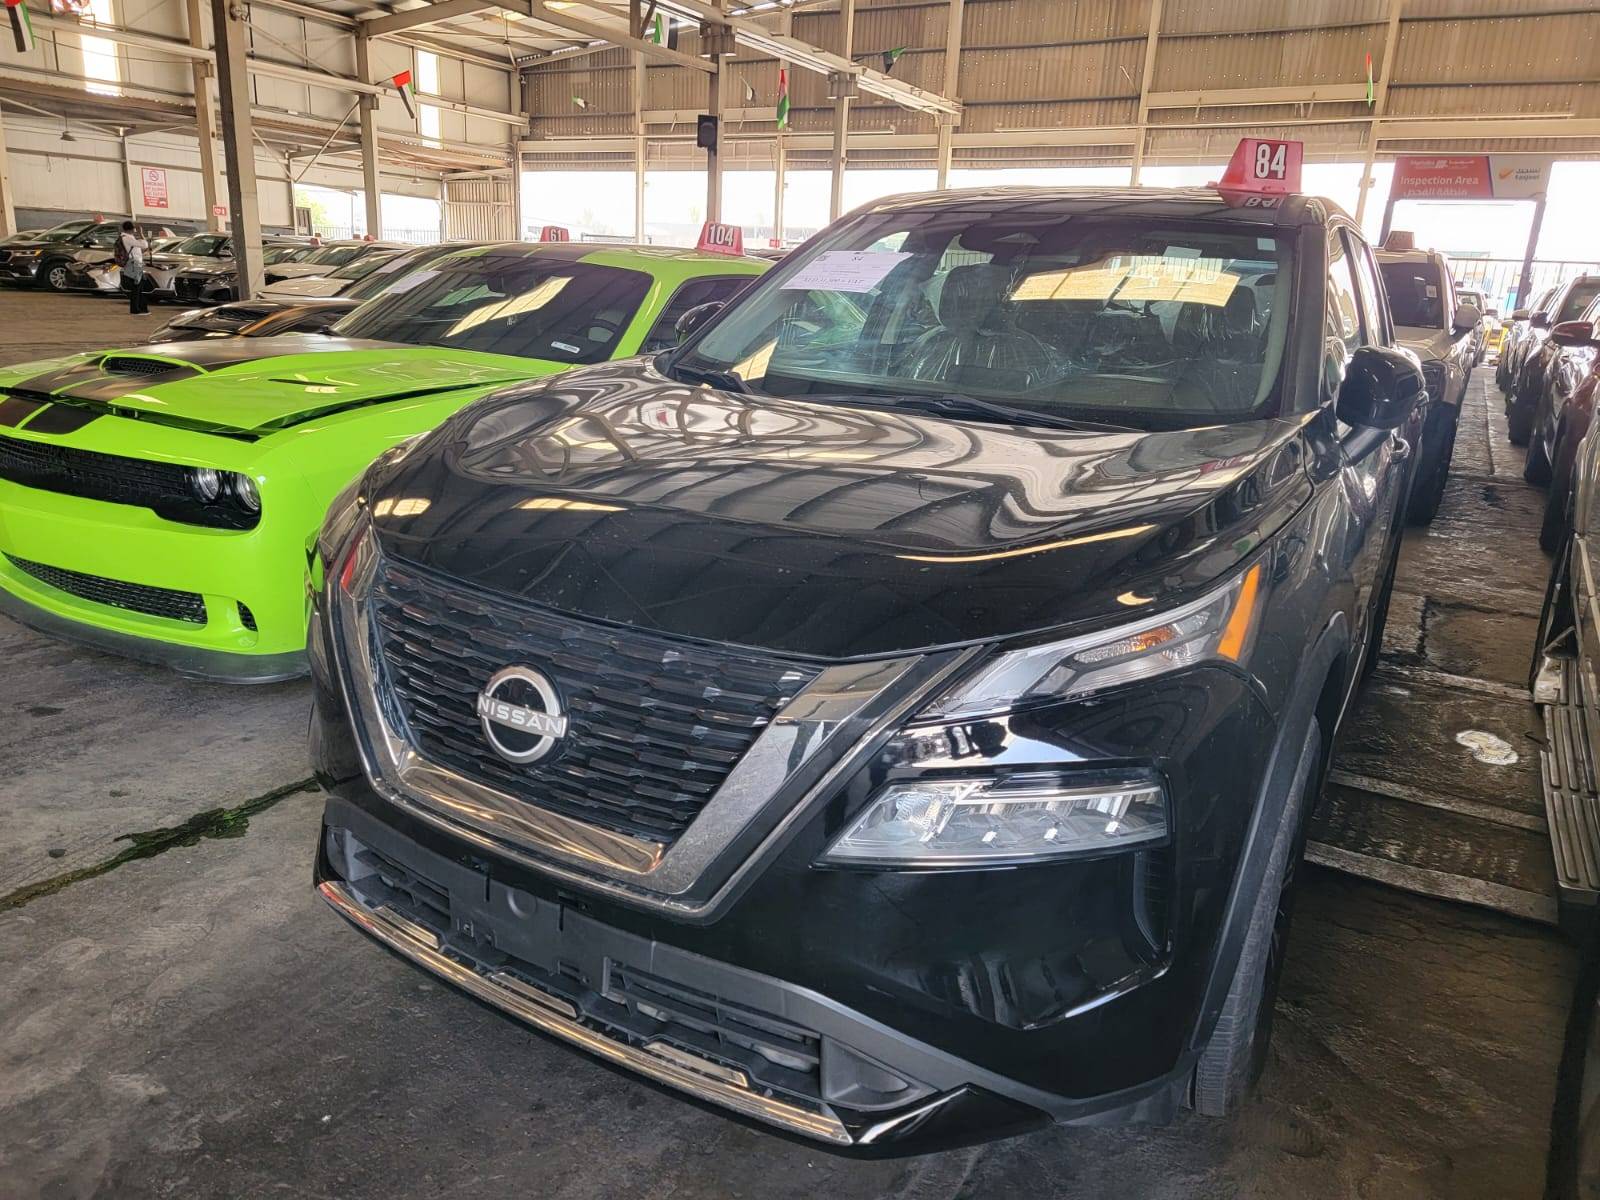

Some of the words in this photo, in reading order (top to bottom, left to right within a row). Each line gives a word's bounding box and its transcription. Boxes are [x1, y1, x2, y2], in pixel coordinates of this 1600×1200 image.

[1256, 143, 1286, 178] 84
[1400, 175, 1452, 187] Inspection
[1454, 175, 1479, 185] Area
[550, 228, 562, 241] 61
[710, 224, 734, 247] 104
[479, 696, 561, 735] NISSAN
